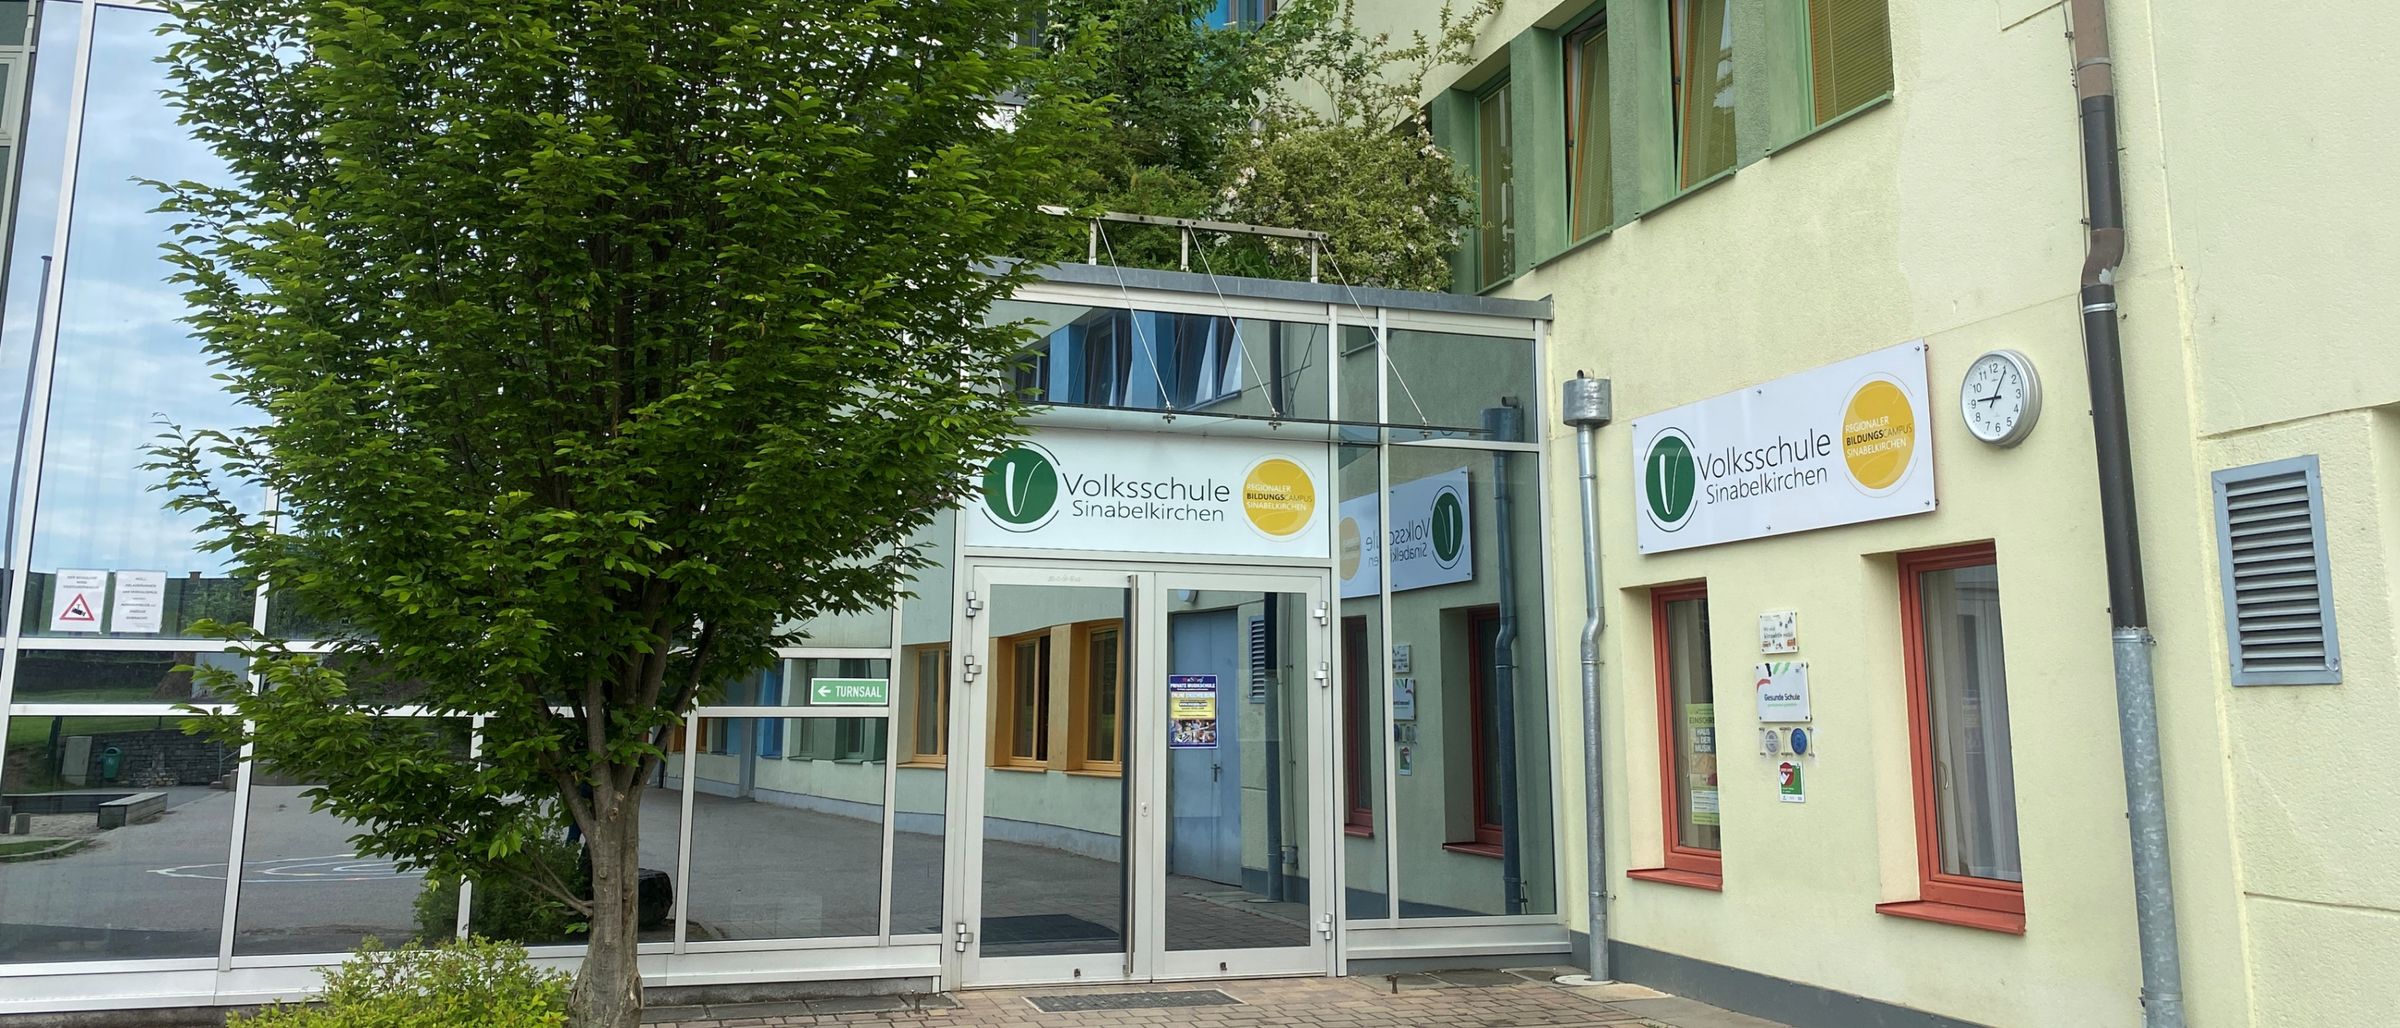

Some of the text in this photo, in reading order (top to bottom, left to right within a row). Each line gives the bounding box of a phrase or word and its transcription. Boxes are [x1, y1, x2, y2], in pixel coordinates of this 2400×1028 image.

[1989, 363, 1998, 374] 12
[1979, 370, 1987, 381] 11
[2011, 374, 2017, 384] 2
[1973, 383, 1982, 393] 10
[2015, 388, 2022, 399] 3
[1971, 399, 1977, 409] 9
[2013, 404, 2019, 413] 4
[1975, 412, 1981, 422] 8
[2006, 416, 2013, 427] 5
[1845, 416, 1889, 433] REGIONALER
[1985, 421, 1991, 431] 7
[1995, 422, 2001, 432] 6
[1846, 423, 1913, 446] BILDUNGSCAMPUS
[1846, 437, 1907, 459] SINABELKIRCHEN
[1697, 428, 1831, 481] Volksschule
[1062, 473, 1230, 502] Volksschule
[1247, 482, 1292, 493] REGIONALER
[1706, 467, 1828, 505] Sinabelkirchen
[1246, 492, 1313, 503] BILDUNGSCAMPUS
[1072, 500, 1224, 522] Sinabelkirchen
[1247, 501, 1307, 512] SINABELKIRCHEN
[835, 685, 882, 698] TURNSAAL
[1764, 693, 1801, 702] Gesunde Schule
[1696, 727, 1711, 736] HAUS
[1700, 736, 1711, 744] DER
[1694, 744, 1712, 753] MUSIK
